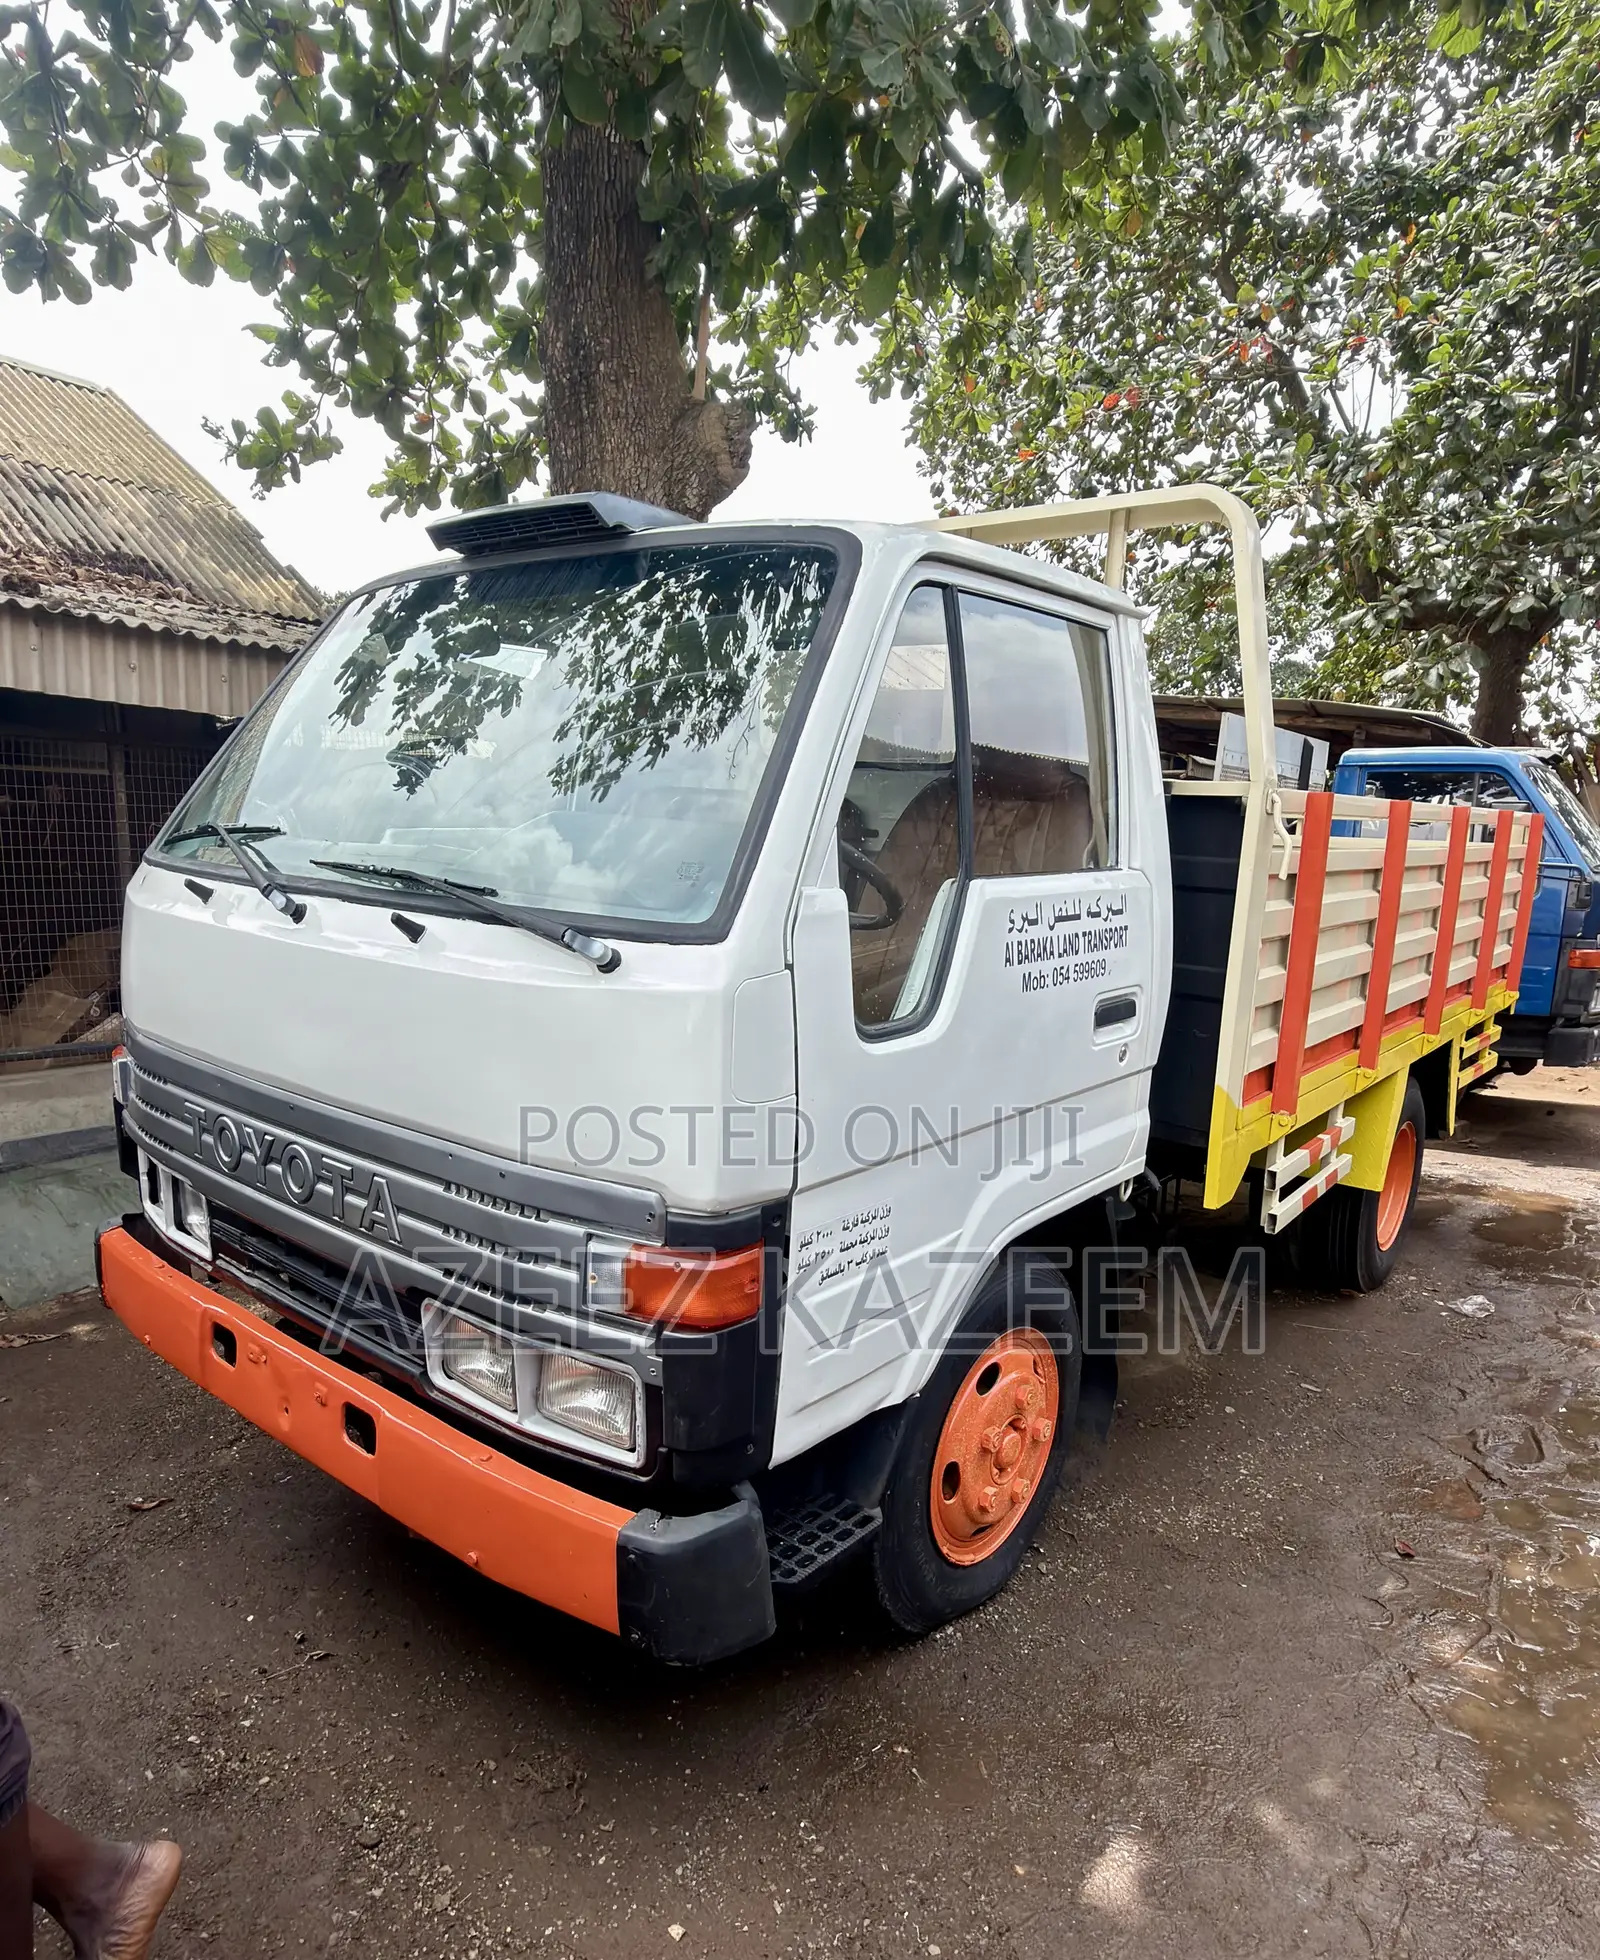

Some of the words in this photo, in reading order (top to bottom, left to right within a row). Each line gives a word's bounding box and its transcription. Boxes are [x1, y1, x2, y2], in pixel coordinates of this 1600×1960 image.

[1017, 935, 1055, 965] BARAKA
[1057, 932, 1080, 958] LAND
[1082, 925, 1128, 954] TRANSPORT
[1022, 970, 1049, 993] Mob:
[1052, 964, 1070, 987] 054
[1073, 958, 1107, 982] 599609
[184, 1100, 402, 1245] TOYOTA
[798, 1231, 814, 1252] كيلو
